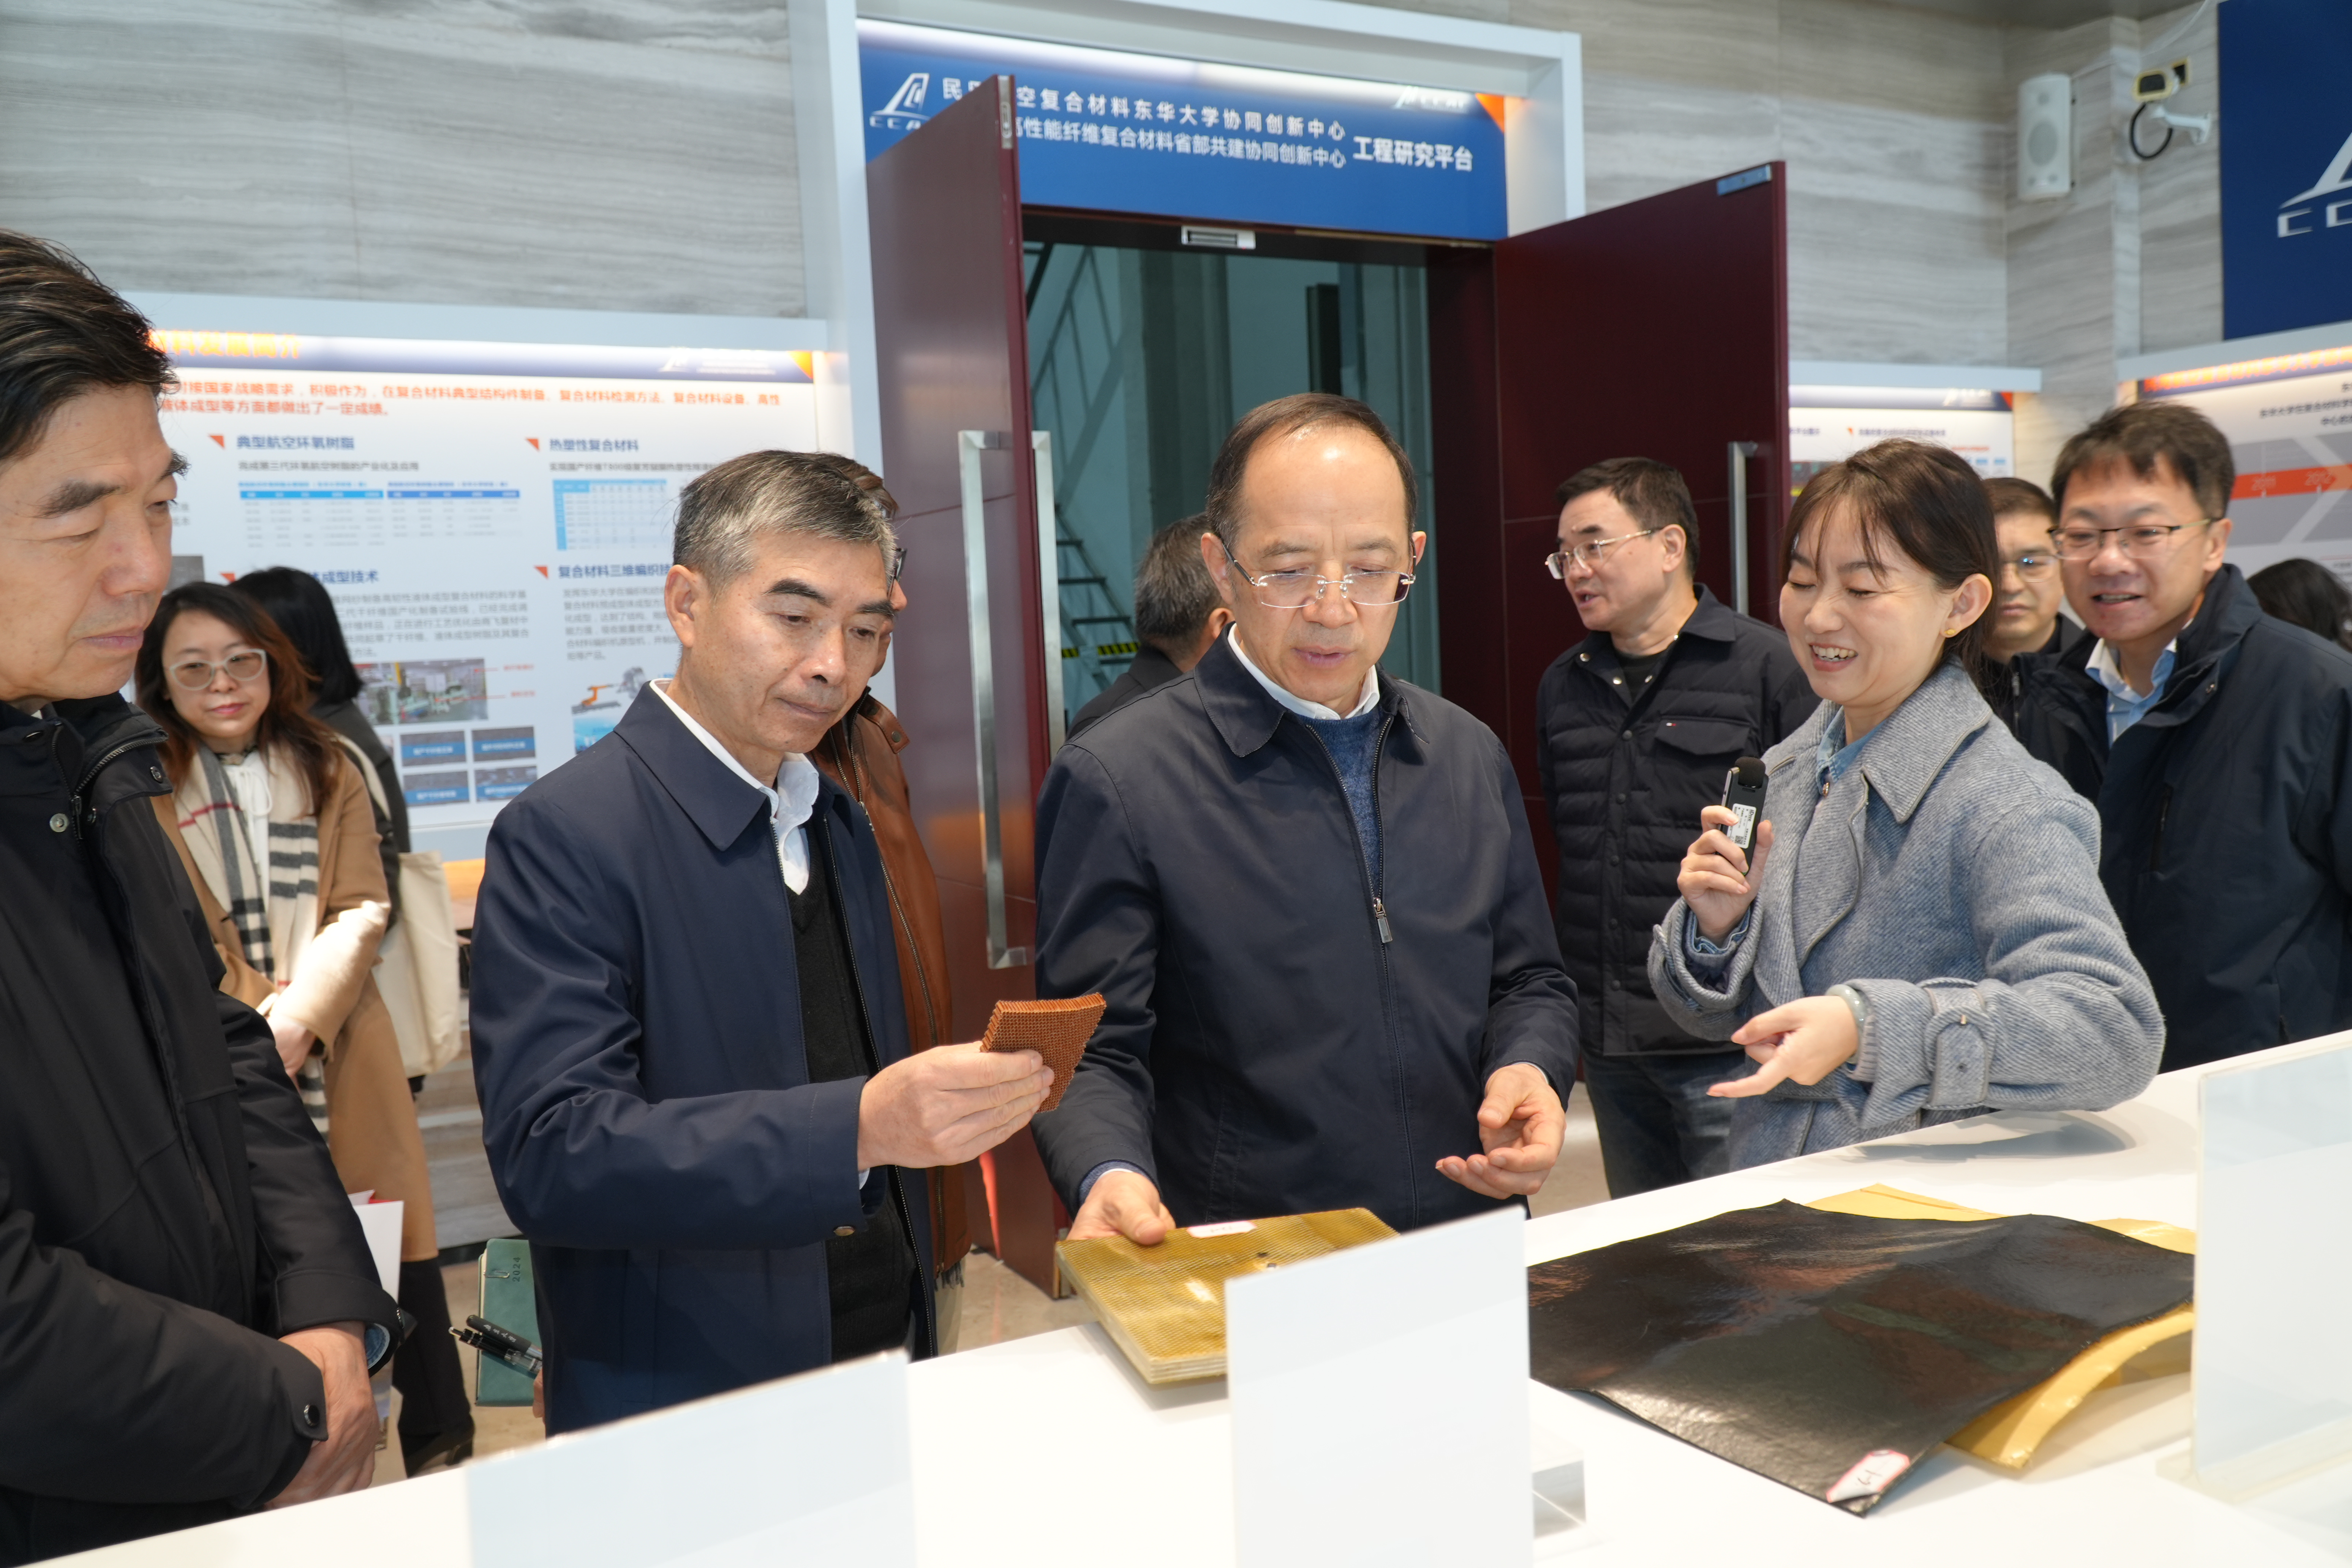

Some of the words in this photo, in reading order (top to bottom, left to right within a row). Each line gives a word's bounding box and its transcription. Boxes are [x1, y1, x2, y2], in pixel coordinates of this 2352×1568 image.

[942, 77, 1345, 141] 民空复合材料东华大学协同创新中心
[1353, 136, 1473, 172] 工程研究平台
[236, 436, 355, 450] 典型航空环氧树脂
[549, 438, 639, 452] 热塑性复合材料
[512, 1257, 521, 1282] 2024
